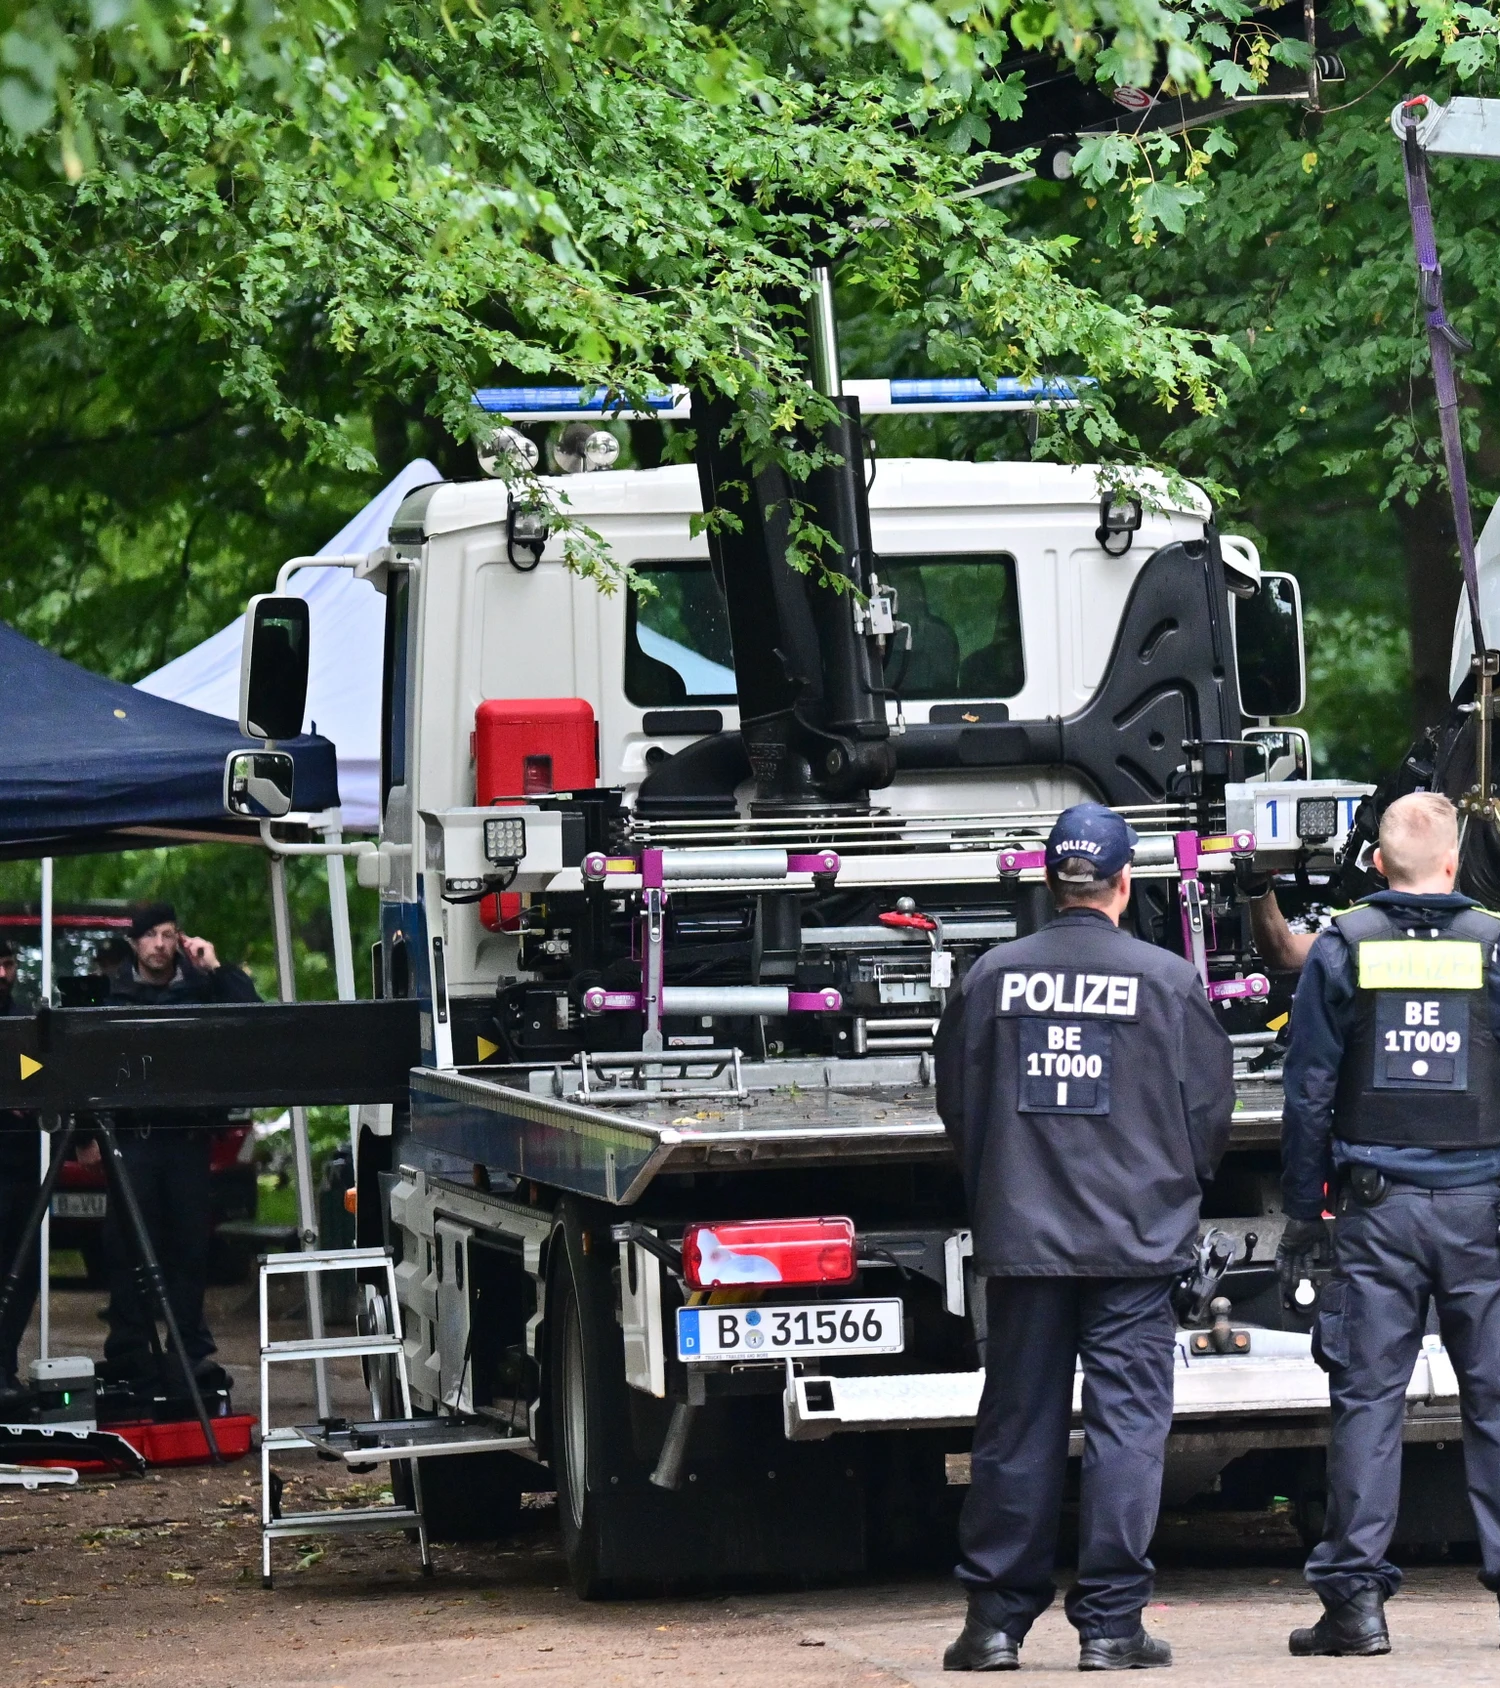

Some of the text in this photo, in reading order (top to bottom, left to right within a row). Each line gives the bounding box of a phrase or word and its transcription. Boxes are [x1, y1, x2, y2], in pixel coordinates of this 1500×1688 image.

[1266, 800, 1278, 838] 1
[1055, 840, 1101, 855] POLIZEI
[1000, 972, 1138, 1016] POLIZEI
[1405, 1001, 1440, 1026] BE
[1047, 1025, 1082, 1051] BE
[1384, 1030, 1461, 1053] 1T009
[1027, 1052, 1102, 1079] 1T000
[686, 1308, 883, 1349] D B 31566
